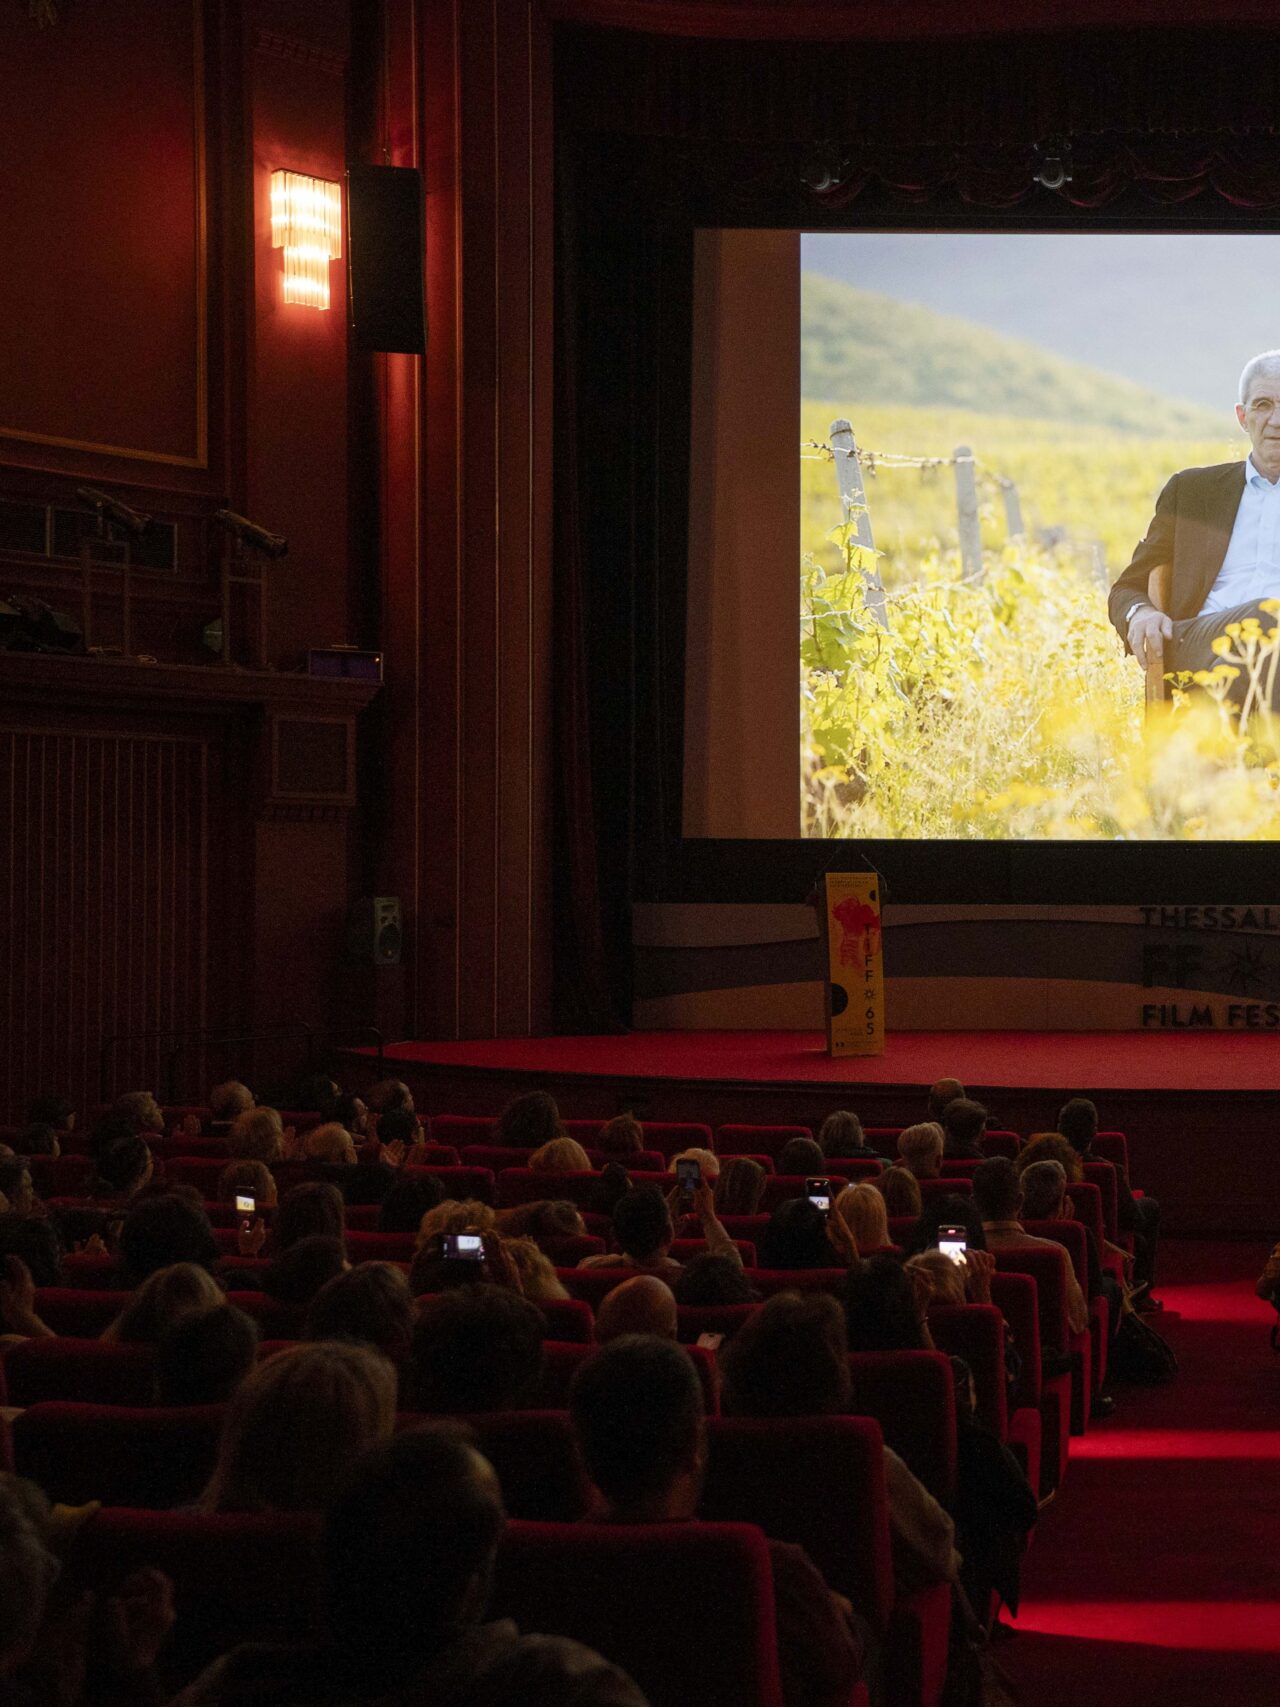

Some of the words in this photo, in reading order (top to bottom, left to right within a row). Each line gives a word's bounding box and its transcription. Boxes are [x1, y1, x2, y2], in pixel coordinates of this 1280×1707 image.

[863, 922, 873, 983] TIFF
[1142, 944, 1204, 988] FF
[865, 1006, 875, 1035] 65
[1142, 1004, 1213, 1027] FILM
